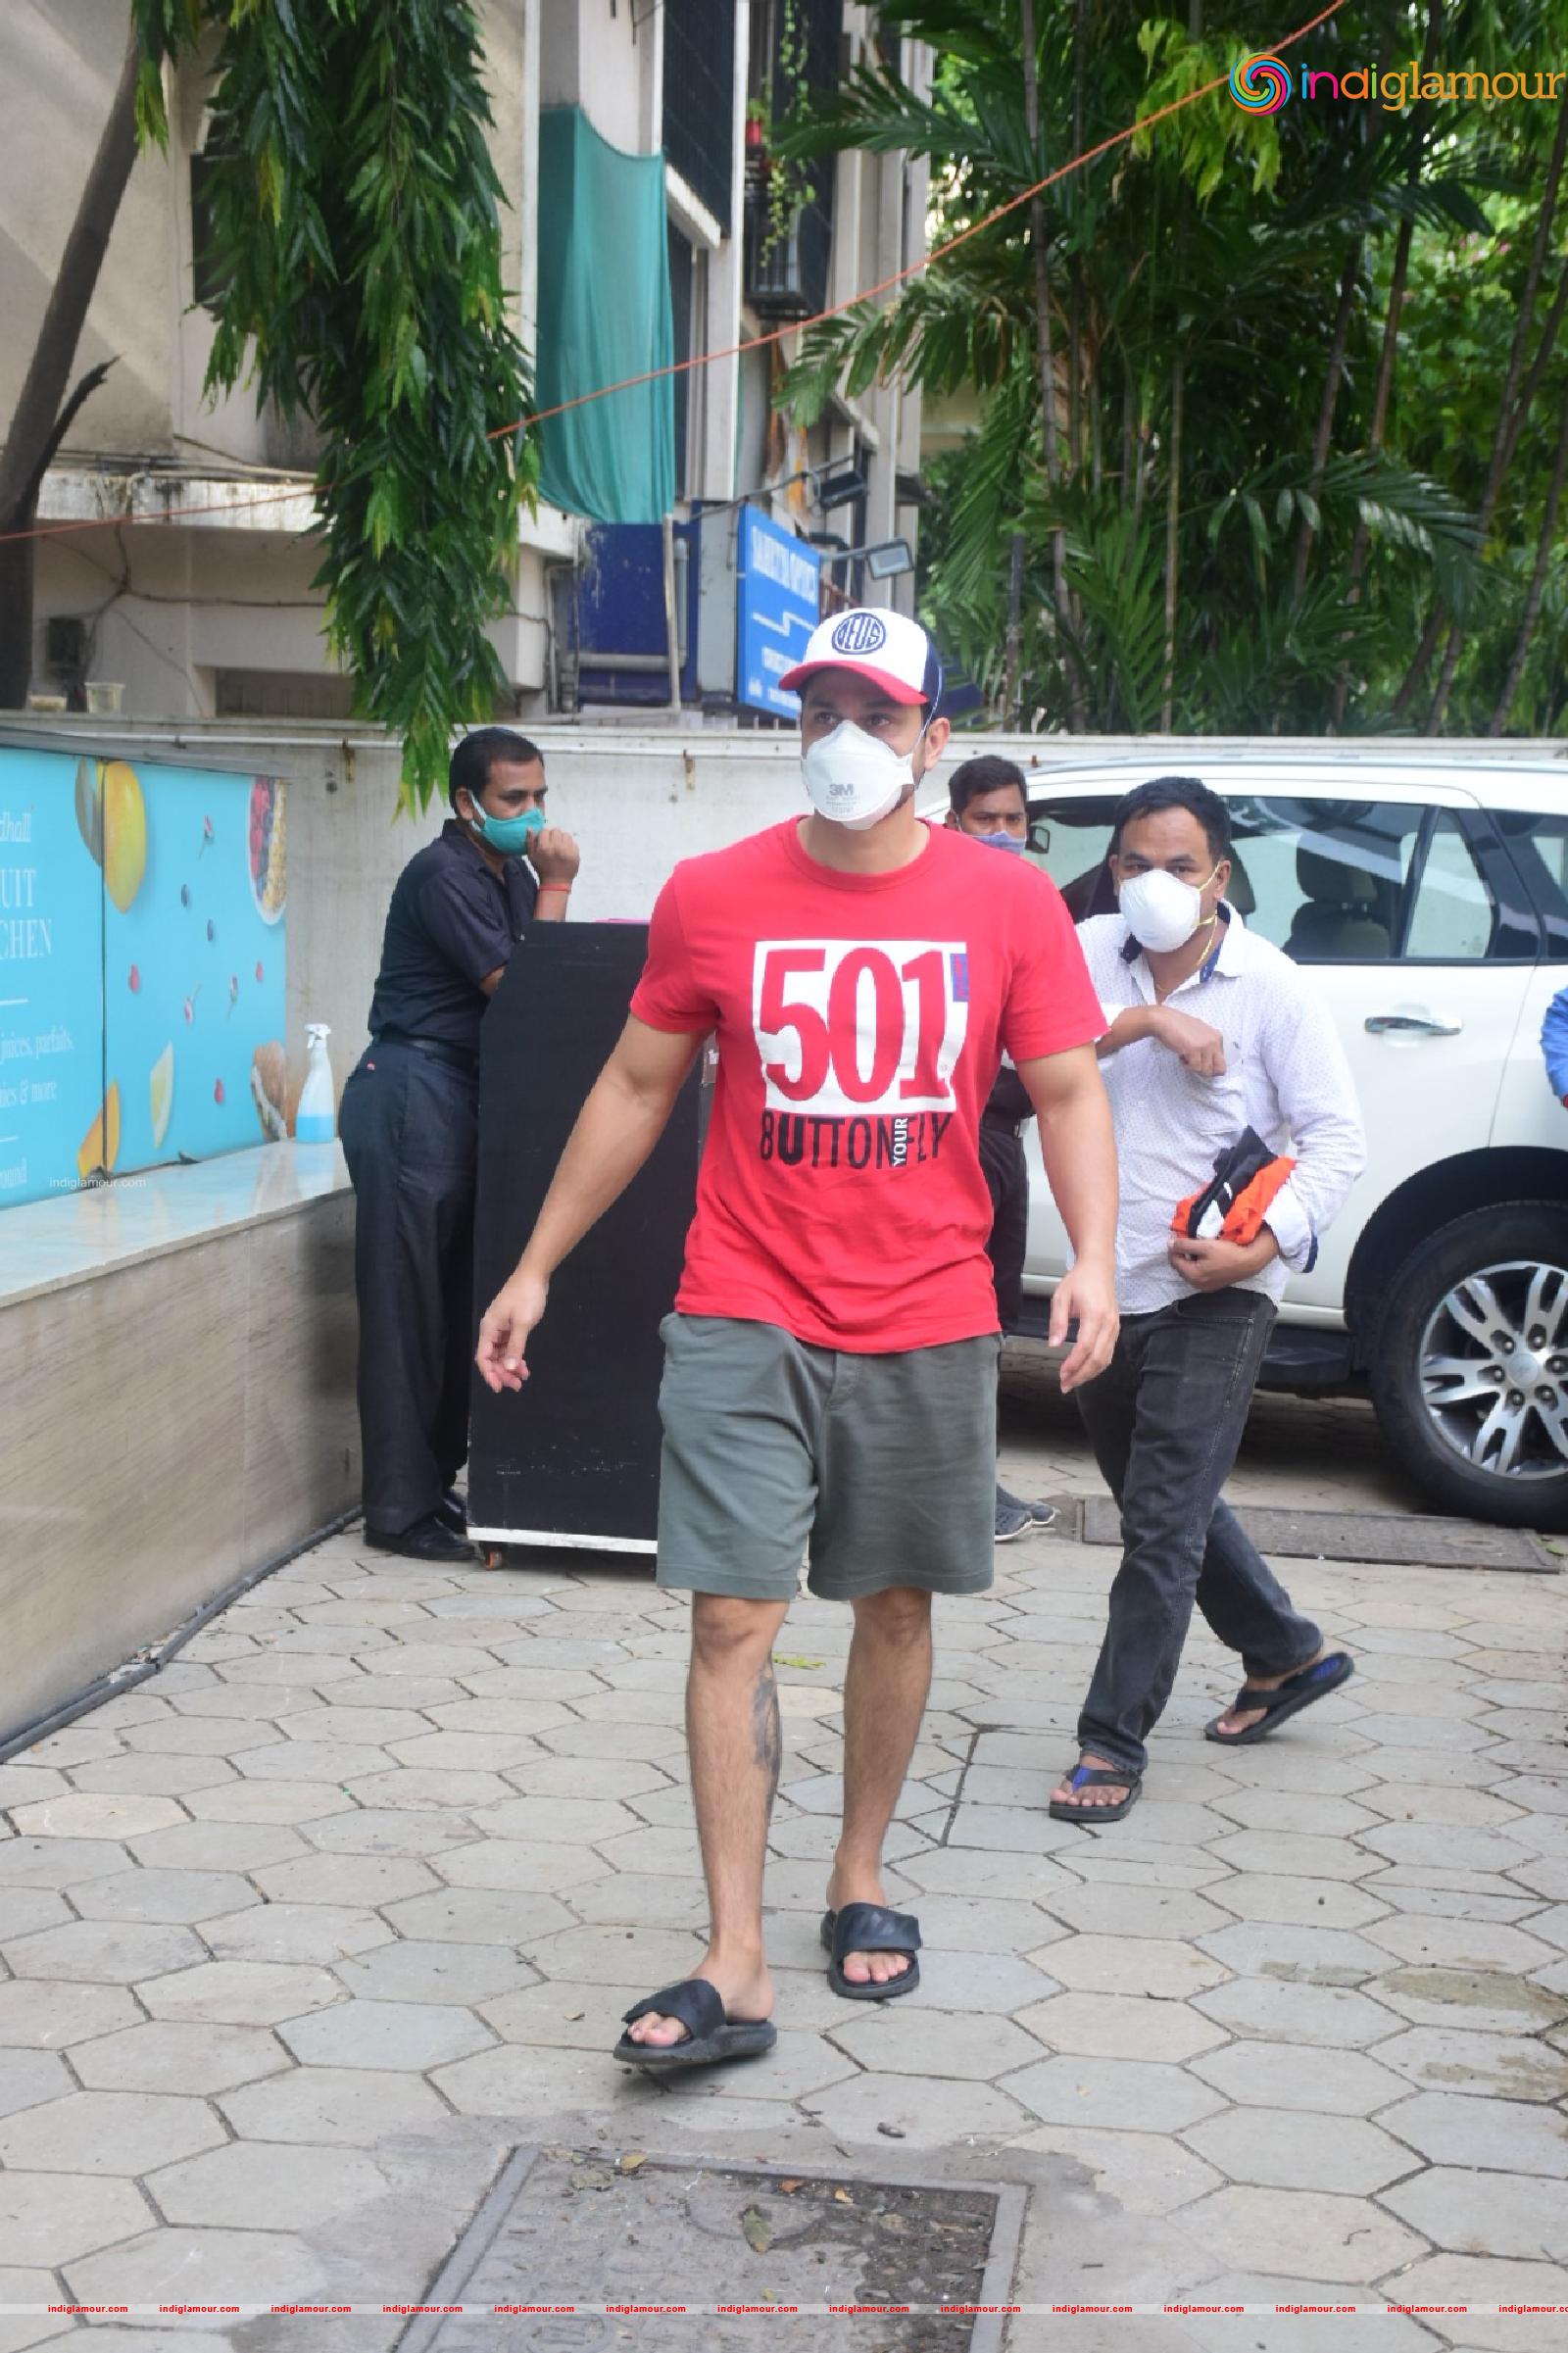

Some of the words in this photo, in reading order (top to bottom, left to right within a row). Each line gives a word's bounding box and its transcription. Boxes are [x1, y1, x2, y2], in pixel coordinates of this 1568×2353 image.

[829, 783, 854, 796] 3M
[760, 947, 950, 1103] 501
[760, 1110, 895, 1169] BUTTON
[893, 1117, 908, 1167] YOUR
